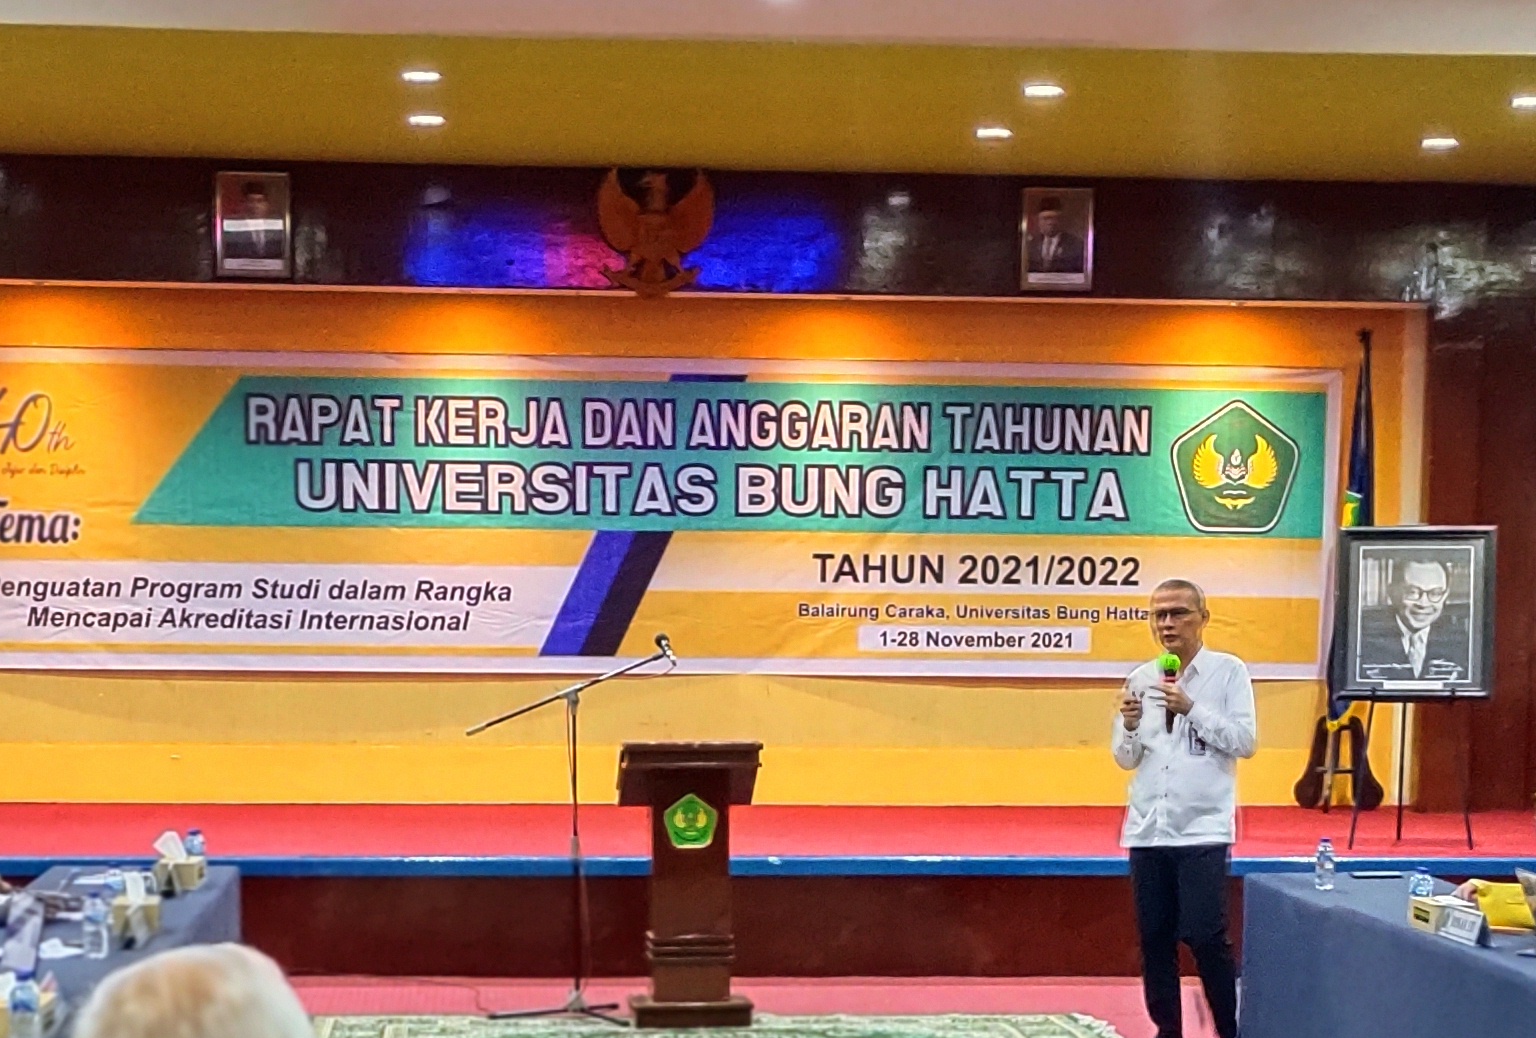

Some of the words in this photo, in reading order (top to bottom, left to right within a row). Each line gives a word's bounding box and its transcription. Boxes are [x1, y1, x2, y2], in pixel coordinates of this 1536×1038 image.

[245, 393, 404, 447] RAPAT
[414, 395, 571, 449] KERJA
[581, 397, 676, 450] DAN
[686, 398, 932, 453] ANGGARAN
[944, 402, 1153, 457] TAHUNAN
[294, 458, 719, 517] UNIVERSITAS
[734, 462, 905, 518] BUNG
[922, 465, 1130, 522] HATTA
[812, 554, 944, 584] TAHUN
[958, 555, 1140, 586] 2021/2022
[130, 577, 243, 603] Program
[252, 578, 321, 600] Studi
[328, 579, 406, 601] dalam
[414, 580, 512, 606] Rangka
[27, 606, 152, 632] Mencapai
[158, 607, 292, 629] Akreditasi
[299, 609, 470, 631] Internasional
[798, 603, 879, 621] Balairung
[885, 604, 950, 620] Caraka,
[956, 605, 1051, 620] Universitas
[1056, 606, 1100, 623] Bung
[1106, 607, 1149, 621] Hatta
[879, 630, 919, 647] 1-28
[926, 631, 1025, 648] November
[1031, 632, 1073, 648] 2021
